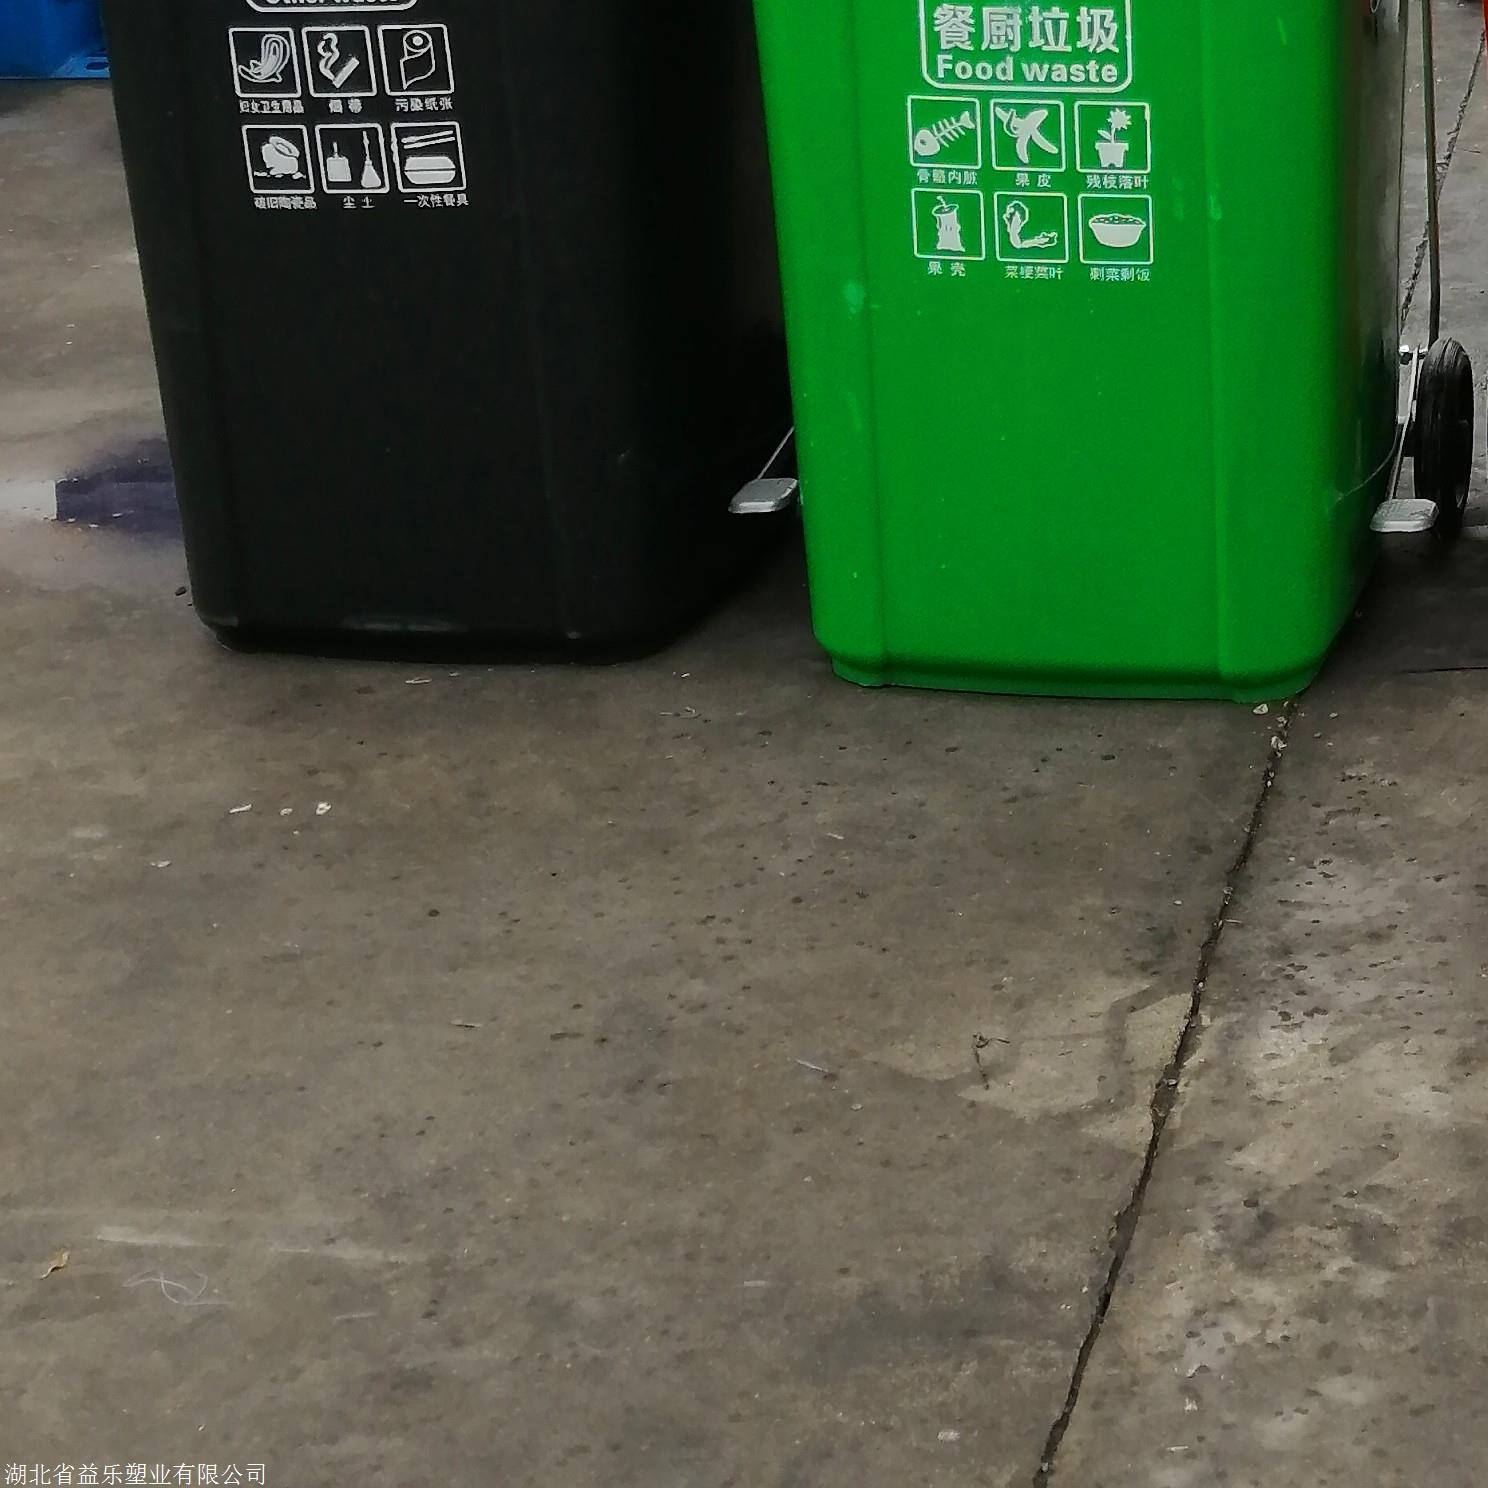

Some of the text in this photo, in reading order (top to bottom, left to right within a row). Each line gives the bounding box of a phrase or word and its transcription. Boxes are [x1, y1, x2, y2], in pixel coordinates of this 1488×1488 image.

[933, 3, 1120, 54] 餐厨垃圾
[936, 55, 1118, 83] Food waste
